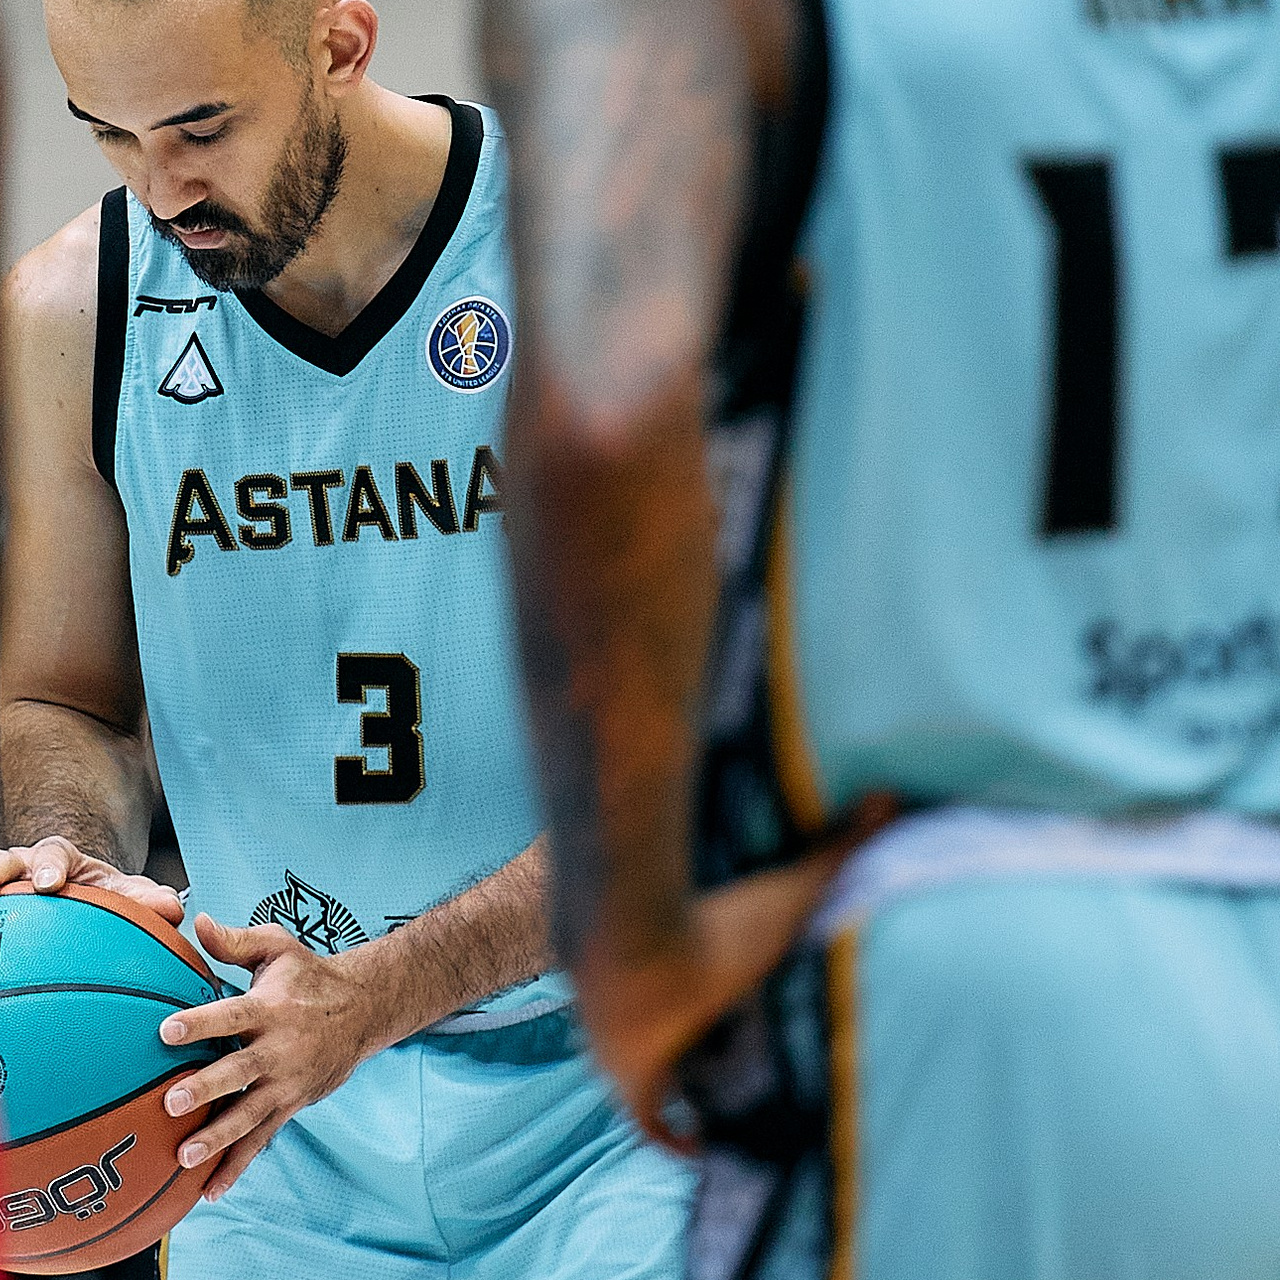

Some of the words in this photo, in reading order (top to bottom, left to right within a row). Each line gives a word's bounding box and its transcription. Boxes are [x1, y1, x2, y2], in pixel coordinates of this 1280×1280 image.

[452, 377, 478, 387] UNITED
[479, 362, 501, 384] LEAGUE
[166, 444, 508, 576] ASTANA
[335, 652, 425, 805] 3
